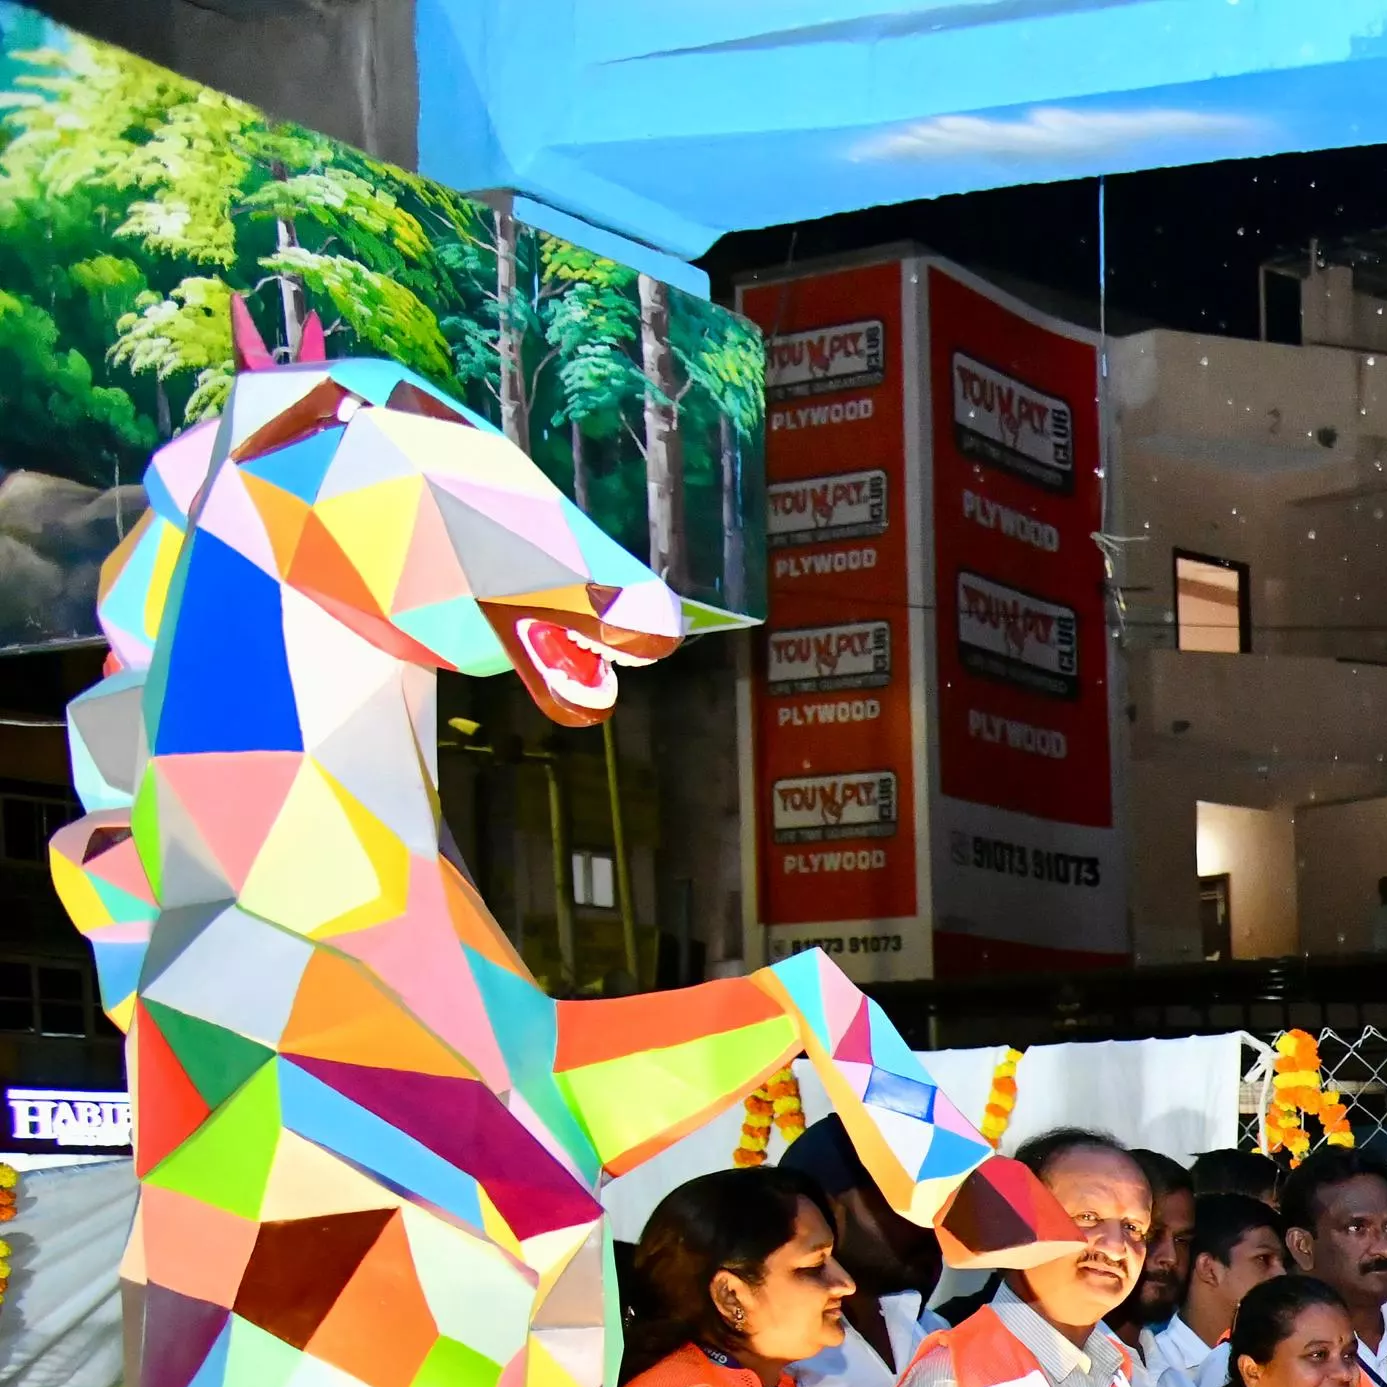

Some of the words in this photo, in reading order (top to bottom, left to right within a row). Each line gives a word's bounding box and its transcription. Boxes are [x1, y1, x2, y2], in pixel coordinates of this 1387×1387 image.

[865, 325, 880, 373] CLUB
[771, 398, 874, 431] PLYWOOD
[1050, 401, 1068, 468] CLUB
[868, 475, 884, 517] CLUB
[962, 488, 1061, 554] PLYWOOD
[775, 547, 877, 579] PLYWOOD
[872, 626, 886, 670] CLUB
[777, 698, 880, 727] PLYWOOD
[968, 708, 1067, 760] PLYWOOD
[877, 777, 891, 820] CLUB
[783, 848, 886, 875] PLYWOOD
[1030, 847, 1100, 887] 91073
[791, 937, 844, 953] 973
[849, 935, 902, 953] 91073
